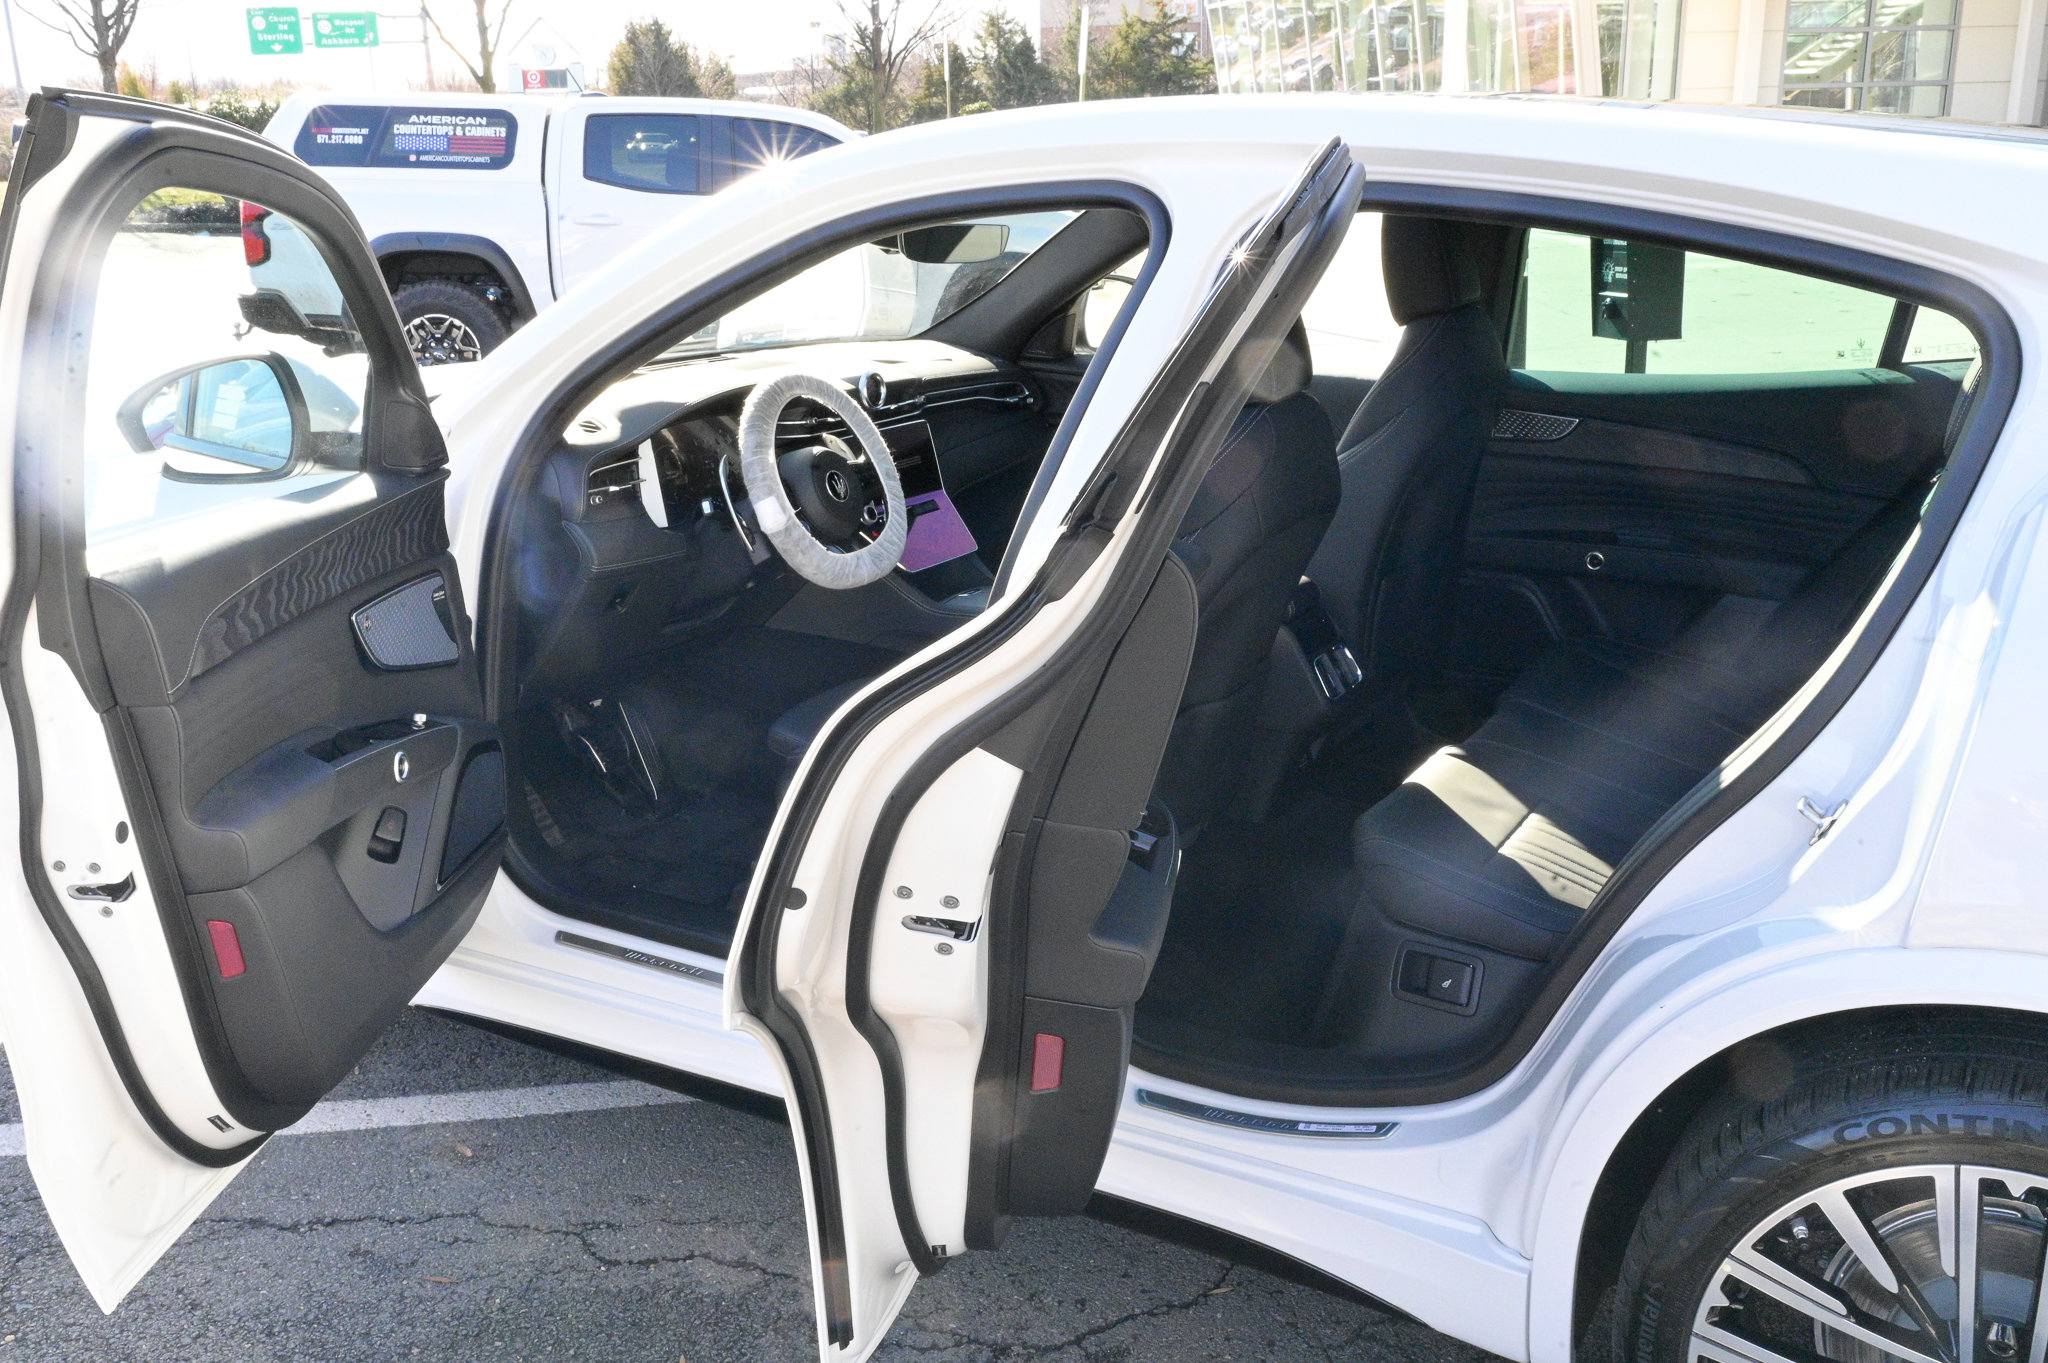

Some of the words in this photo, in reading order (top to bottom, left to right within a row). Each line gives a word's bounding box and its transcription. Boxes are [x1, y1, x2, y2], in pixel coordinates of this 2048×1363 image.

[257, 33, 294, 41] Sterling
[321, 37, 359, 45] Ashburn
[408, 115, 487, 125] AMERICAN
[393, 124, 454, 136] COUNTERTOPS
[455, 126, 463, 136] &
[465, 126, 506, 138] CABINETS
[1832, 1113, 2048, 1147] CONTIN
